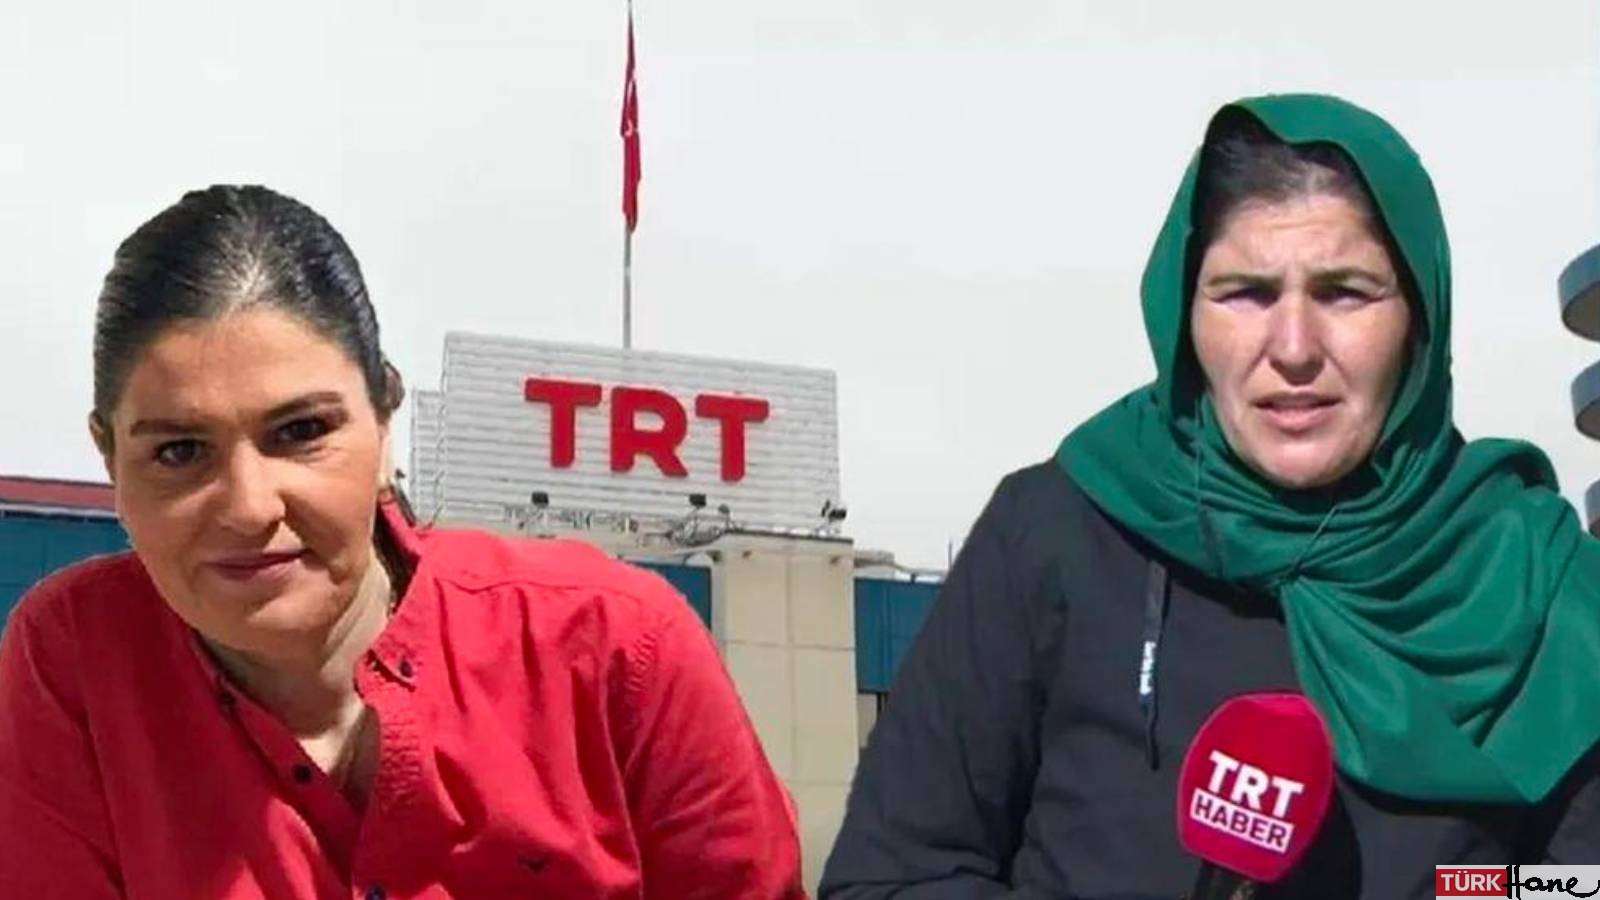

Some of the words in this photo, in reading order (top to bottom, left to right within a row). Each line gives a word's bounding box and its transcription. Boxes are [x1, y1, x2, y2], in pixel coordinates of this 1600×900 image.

[524, 377, 770, 483] TRT
[1209, 749, 1305, 819] TRT
[1194, 794, 1288, 848] HABER
